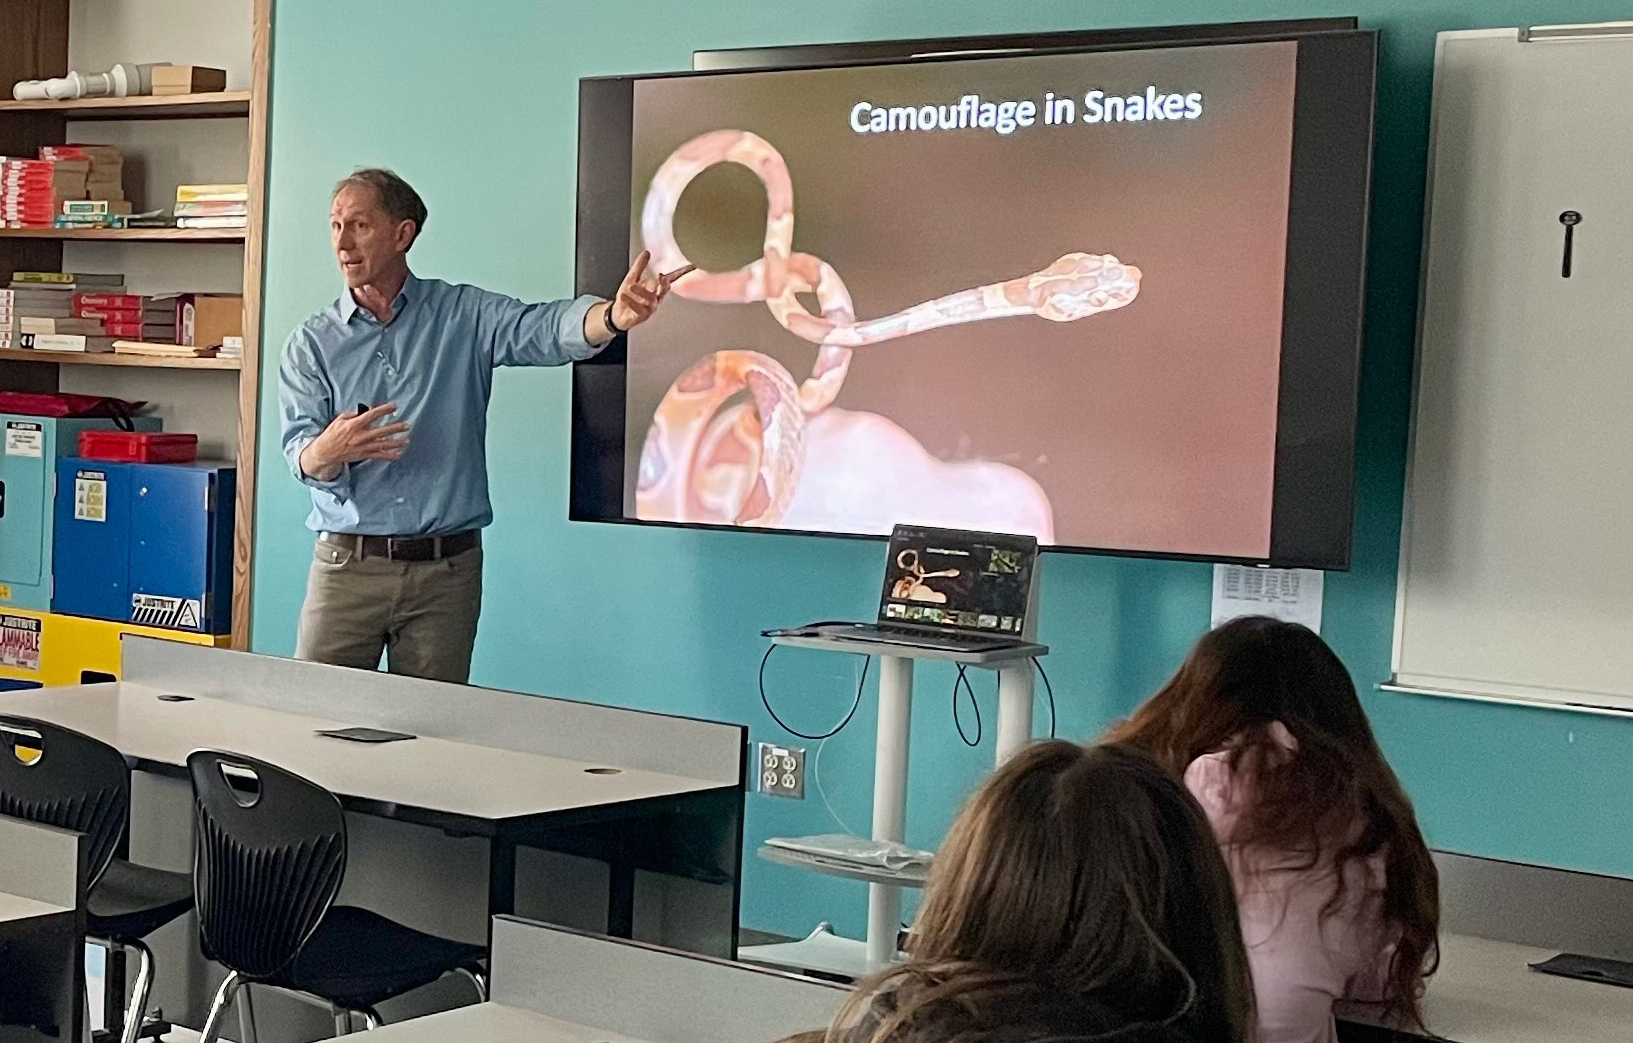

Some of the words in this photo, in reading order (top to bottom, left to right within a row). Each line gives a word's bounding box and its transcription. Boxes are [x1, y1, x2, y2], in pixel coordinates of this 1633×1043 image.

[849, 94, 1036, 134] Camouflage
[1044, 91, 1075, 125] in
[1083, 85, 1203, 123] Snakes
